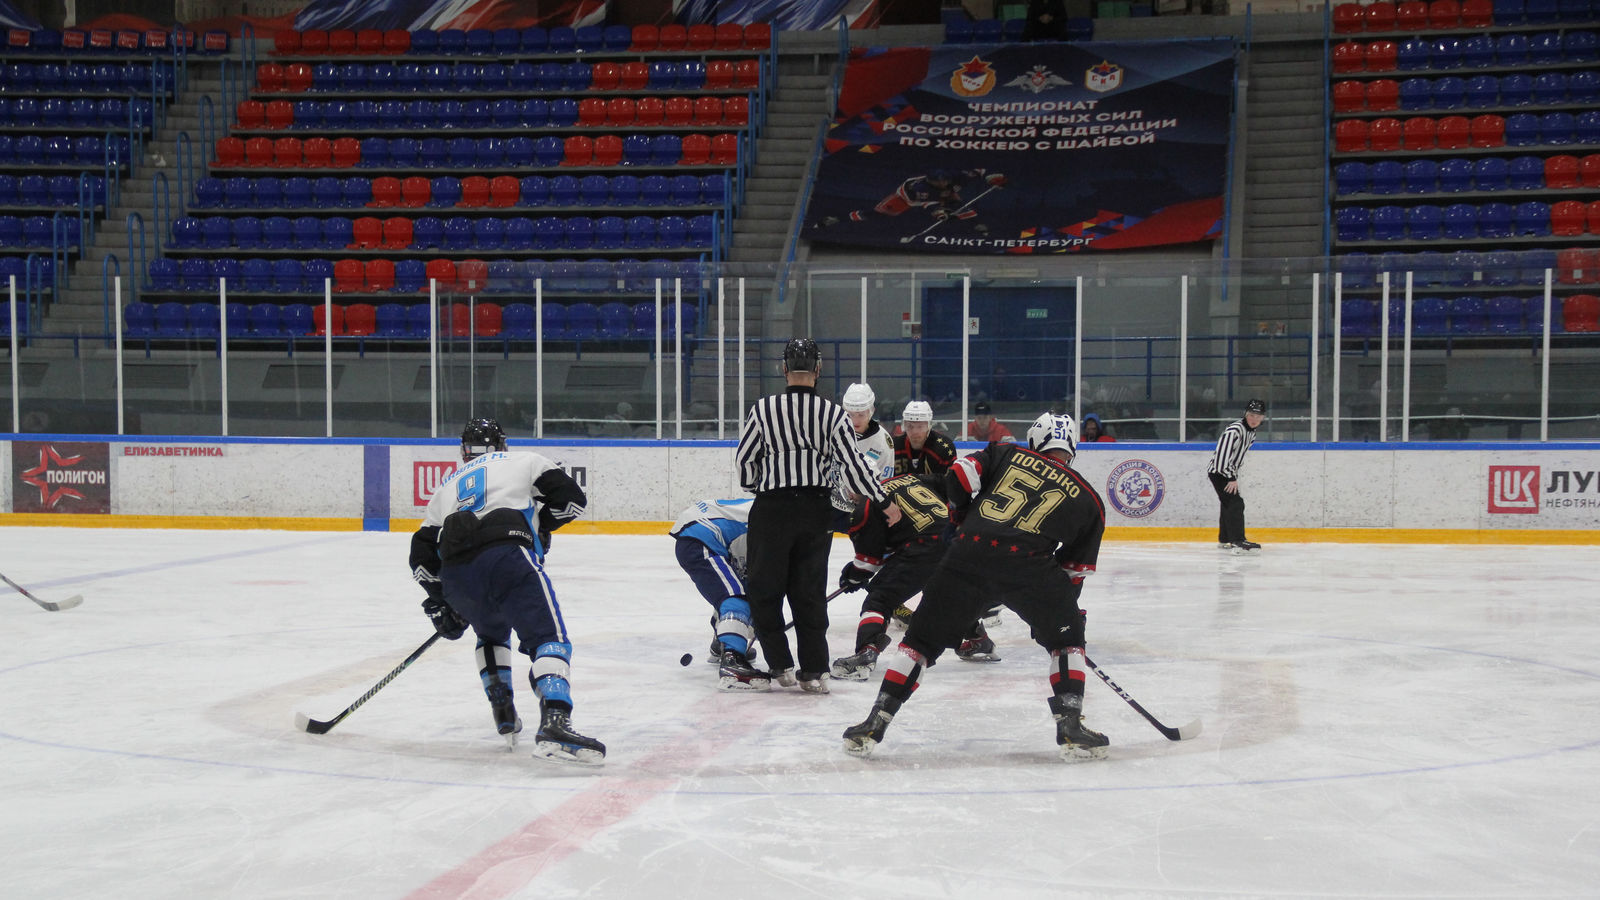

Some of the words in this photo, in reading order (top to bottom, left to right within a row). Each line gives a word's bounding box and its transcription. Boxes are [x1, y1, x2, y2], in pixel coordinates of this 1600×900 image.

[967, 100, 1098, 111] ЧЕМПИОНАТ
[920, 113, 1090, 125] ВООРУЖЕННЫХ
[1095, 110, 1142, 122] СИЛ
[882, 122, 1036, 138] РОССИЙСКОЙ
[1042, 118, 1177, 137] ФЕДЕРАЦИИ
[899, 136, 931, 147] ПО
[936, 139, 1030, 150] ХОККЕЮ
[1035, 139, 1050, 150] С
[1056, 132, 1155, 149] ШАЙБОЙ
[924, 235, 1094, 247] САНКТ-ПЕТЕРБУРГ
[1054, 428, 1066, 440] 51
[124, 446, 223, 457] ЕЛИЗАВЕТИНКА
[46, 470, 105, 485] ПОЛИГОН
[1011, 452, 1081, 499] ПОСТЫКО
[1546, 471, 1600, 493] ЛУ
[456, 466, 487, 512] 9
[1493, 470, 1537, 508] LUK
[894, 484, 949, 532] 19
[978, 464, 1067, 534] 51
[1120, 506, 1151, 517] РОССИИ
